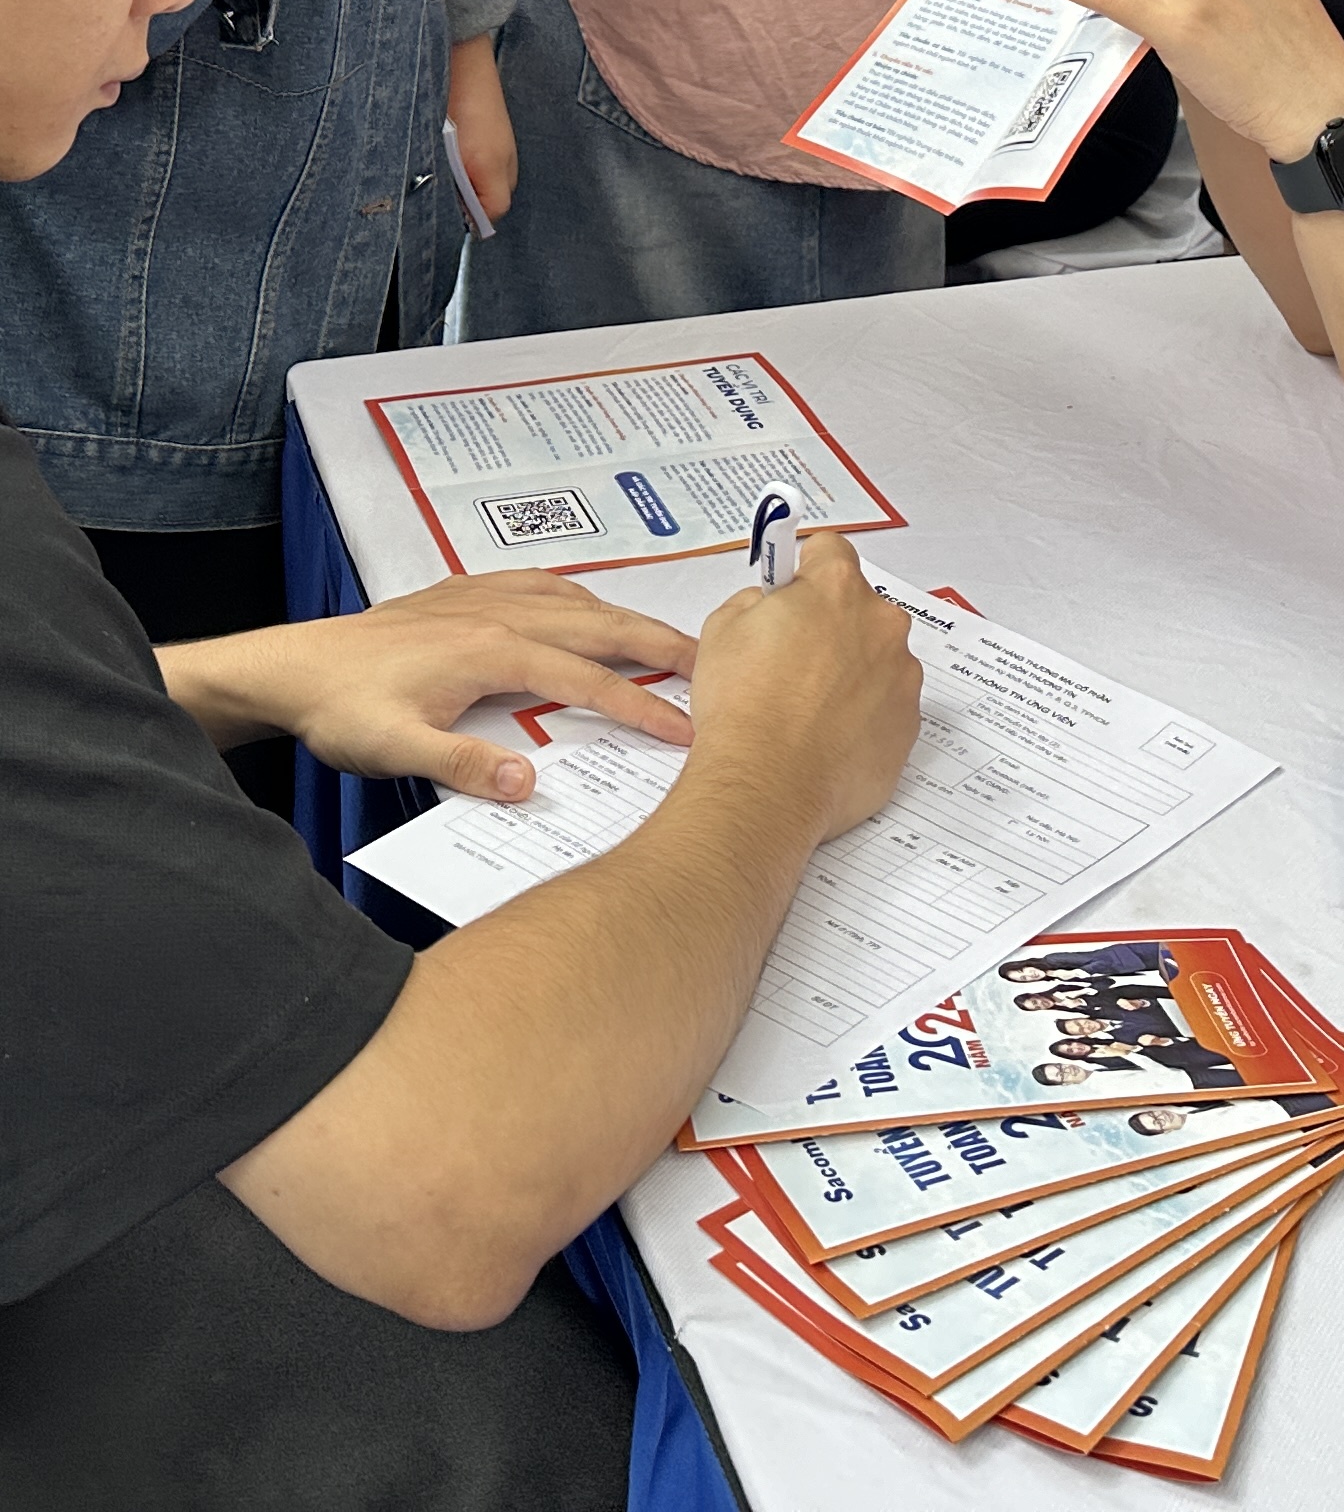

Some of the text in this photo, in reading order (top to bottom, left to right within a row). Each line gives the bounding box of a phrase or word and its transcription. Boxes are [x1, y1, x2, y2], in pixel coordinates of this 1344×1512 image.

[703, 366, 763, 429] TUYỂN DỤNG
[725, 364, 749, 379] CÁC
[750, 389, 770, 404] TRÍ
[874, 585, 955, 633] Sacombank
[950, 663, 1076, 727] BẢN THÔNG TIN ỨNG VIÊN
[802, 1136, 854, 1203] Sacom
[872, 1124, 953, 1192] TUYỂN
[937, 1119, 1008, 1176] TOÀN
